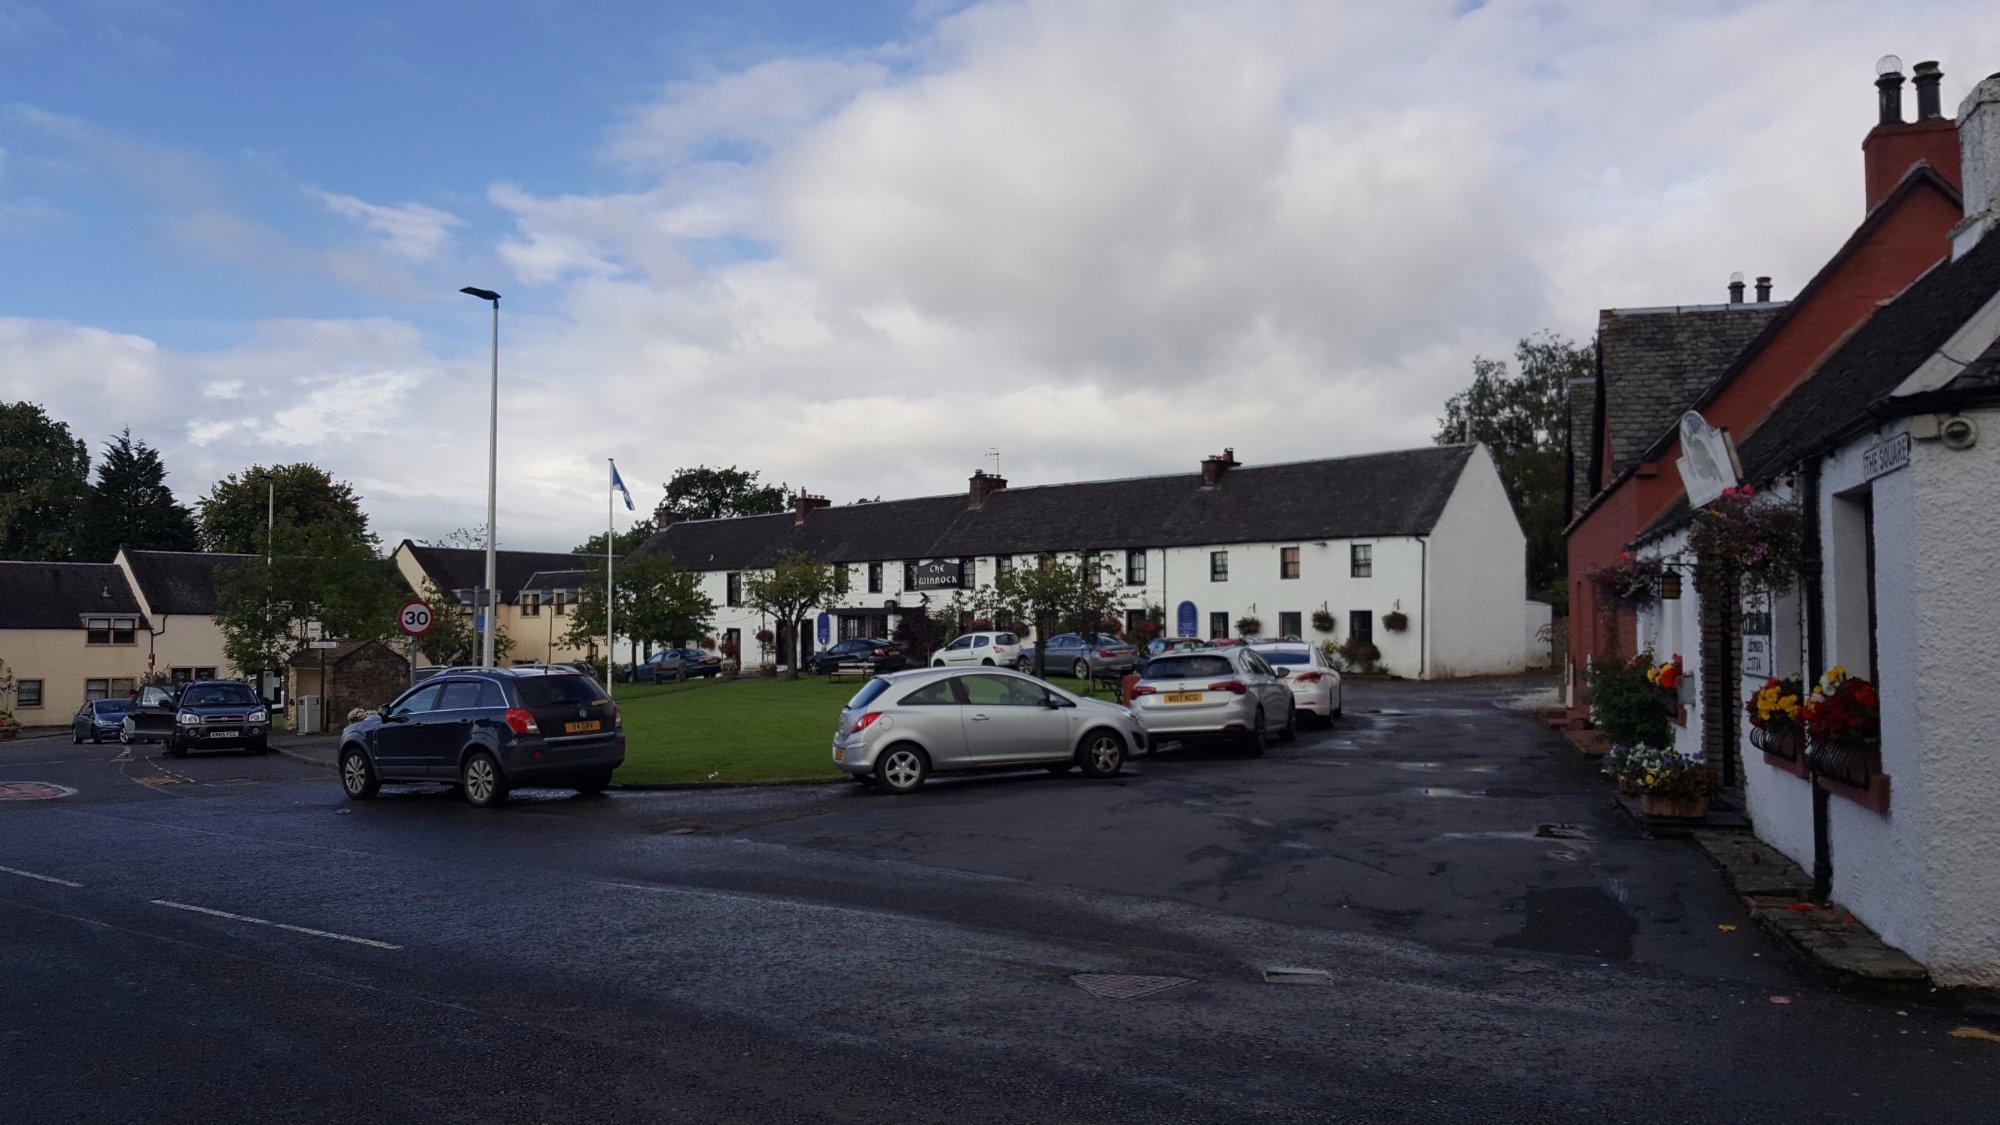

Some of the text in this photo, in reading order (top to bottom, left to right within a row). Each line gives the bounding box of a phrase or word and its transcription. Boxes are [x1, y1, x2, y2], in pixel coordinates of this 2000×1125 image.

[1864, 438, 1908, 475] THE SQUARE
[918, 575, 958, 585] WINNOCK
[404, 611, 429, 625] 30
